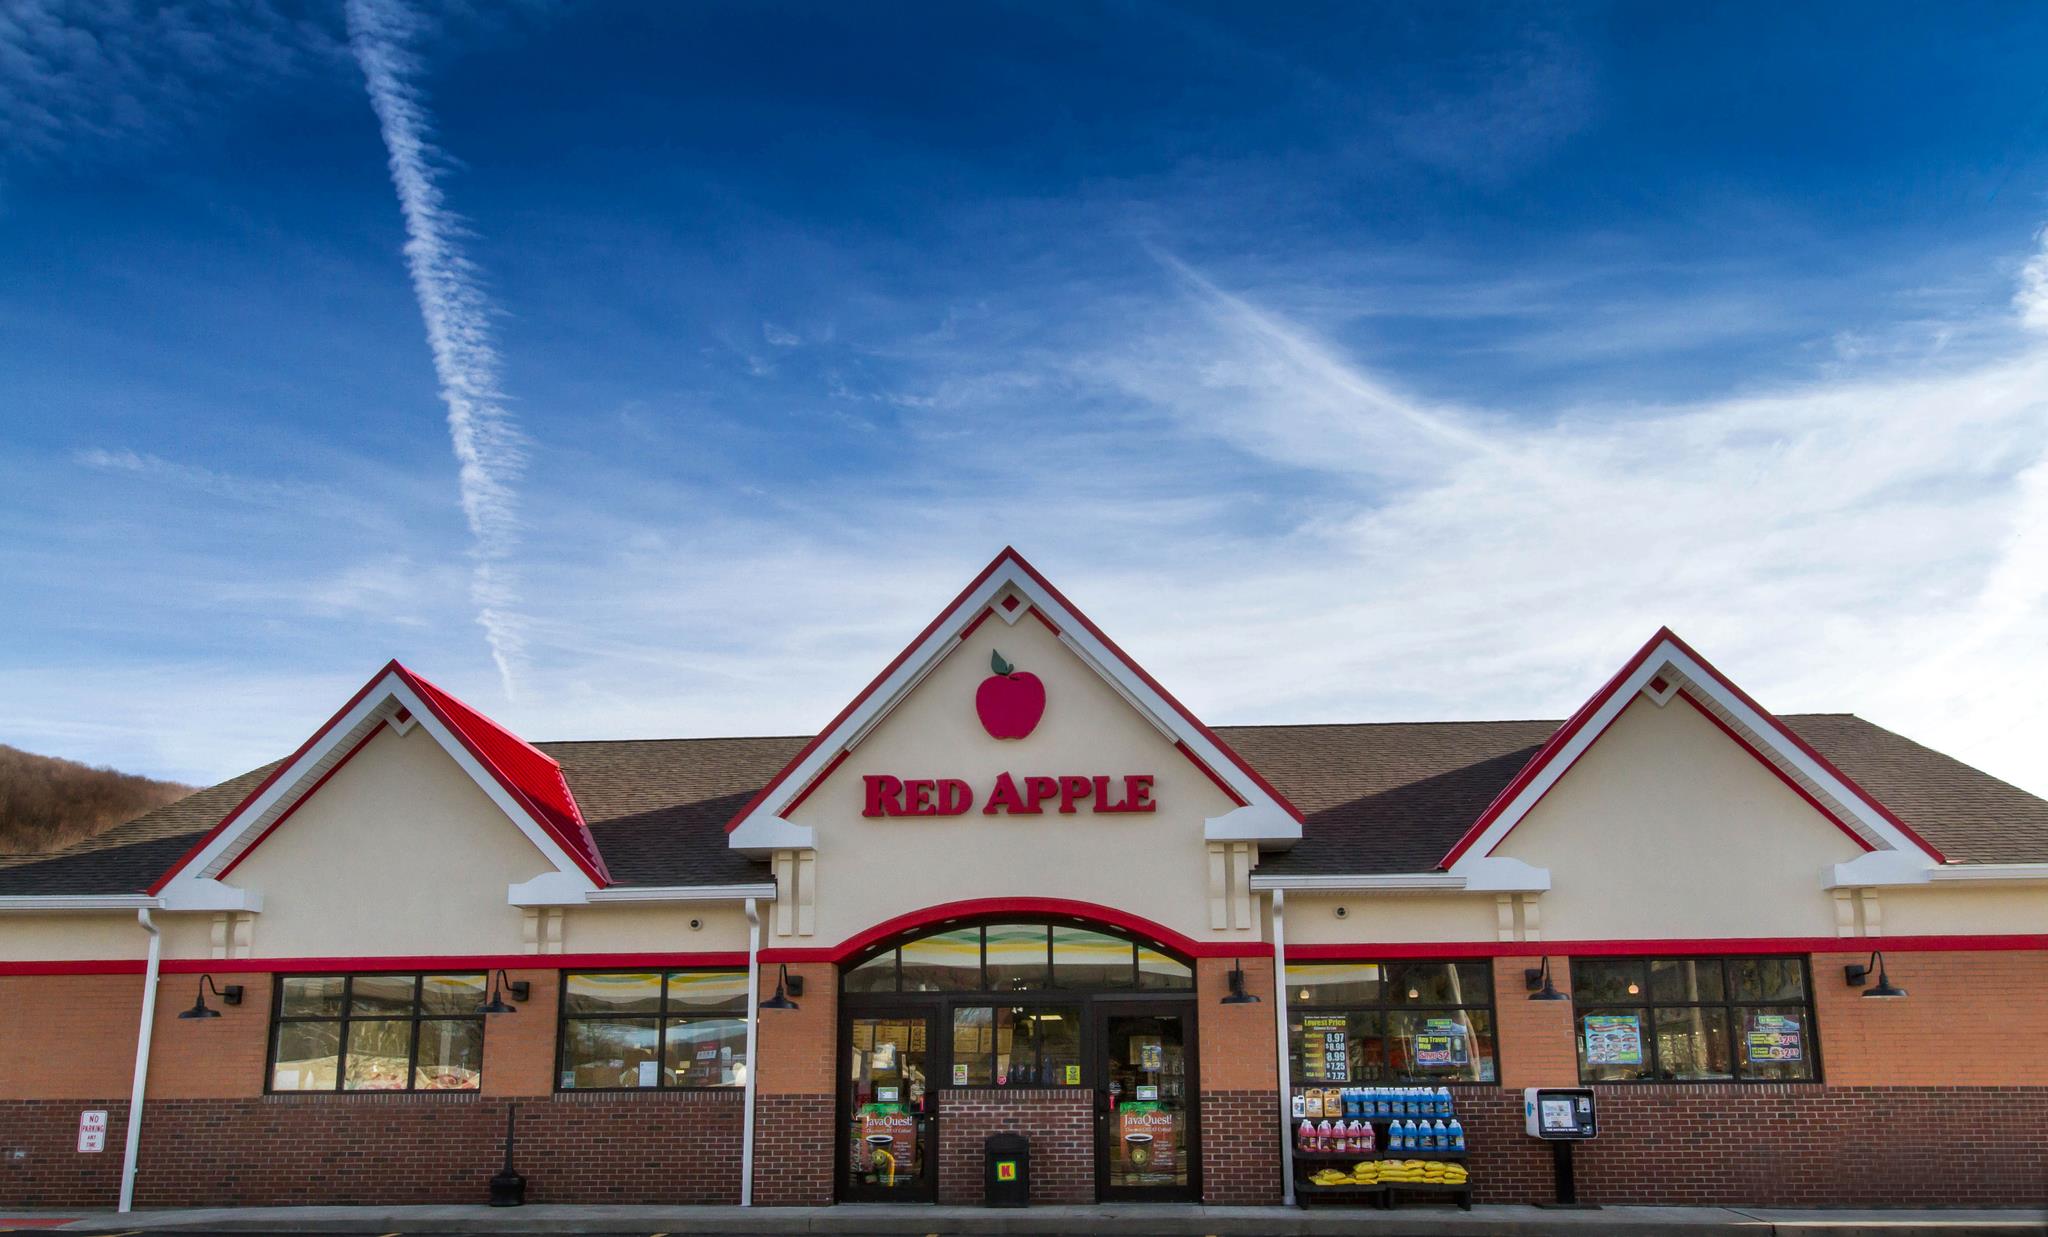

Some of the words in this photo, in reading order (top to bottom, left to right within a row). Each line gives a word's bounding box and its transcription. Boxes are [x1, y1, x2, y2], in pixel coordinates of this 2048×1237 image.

[861, 774, 974, 818] RED
[982, 771, 1157, 814] APPLE
[89, 1115, 99, 1123] NO
[866, 1115, 913, 1127] JavaQuest!
[1124, 1114, 1172, 1126] JavaQuest!
